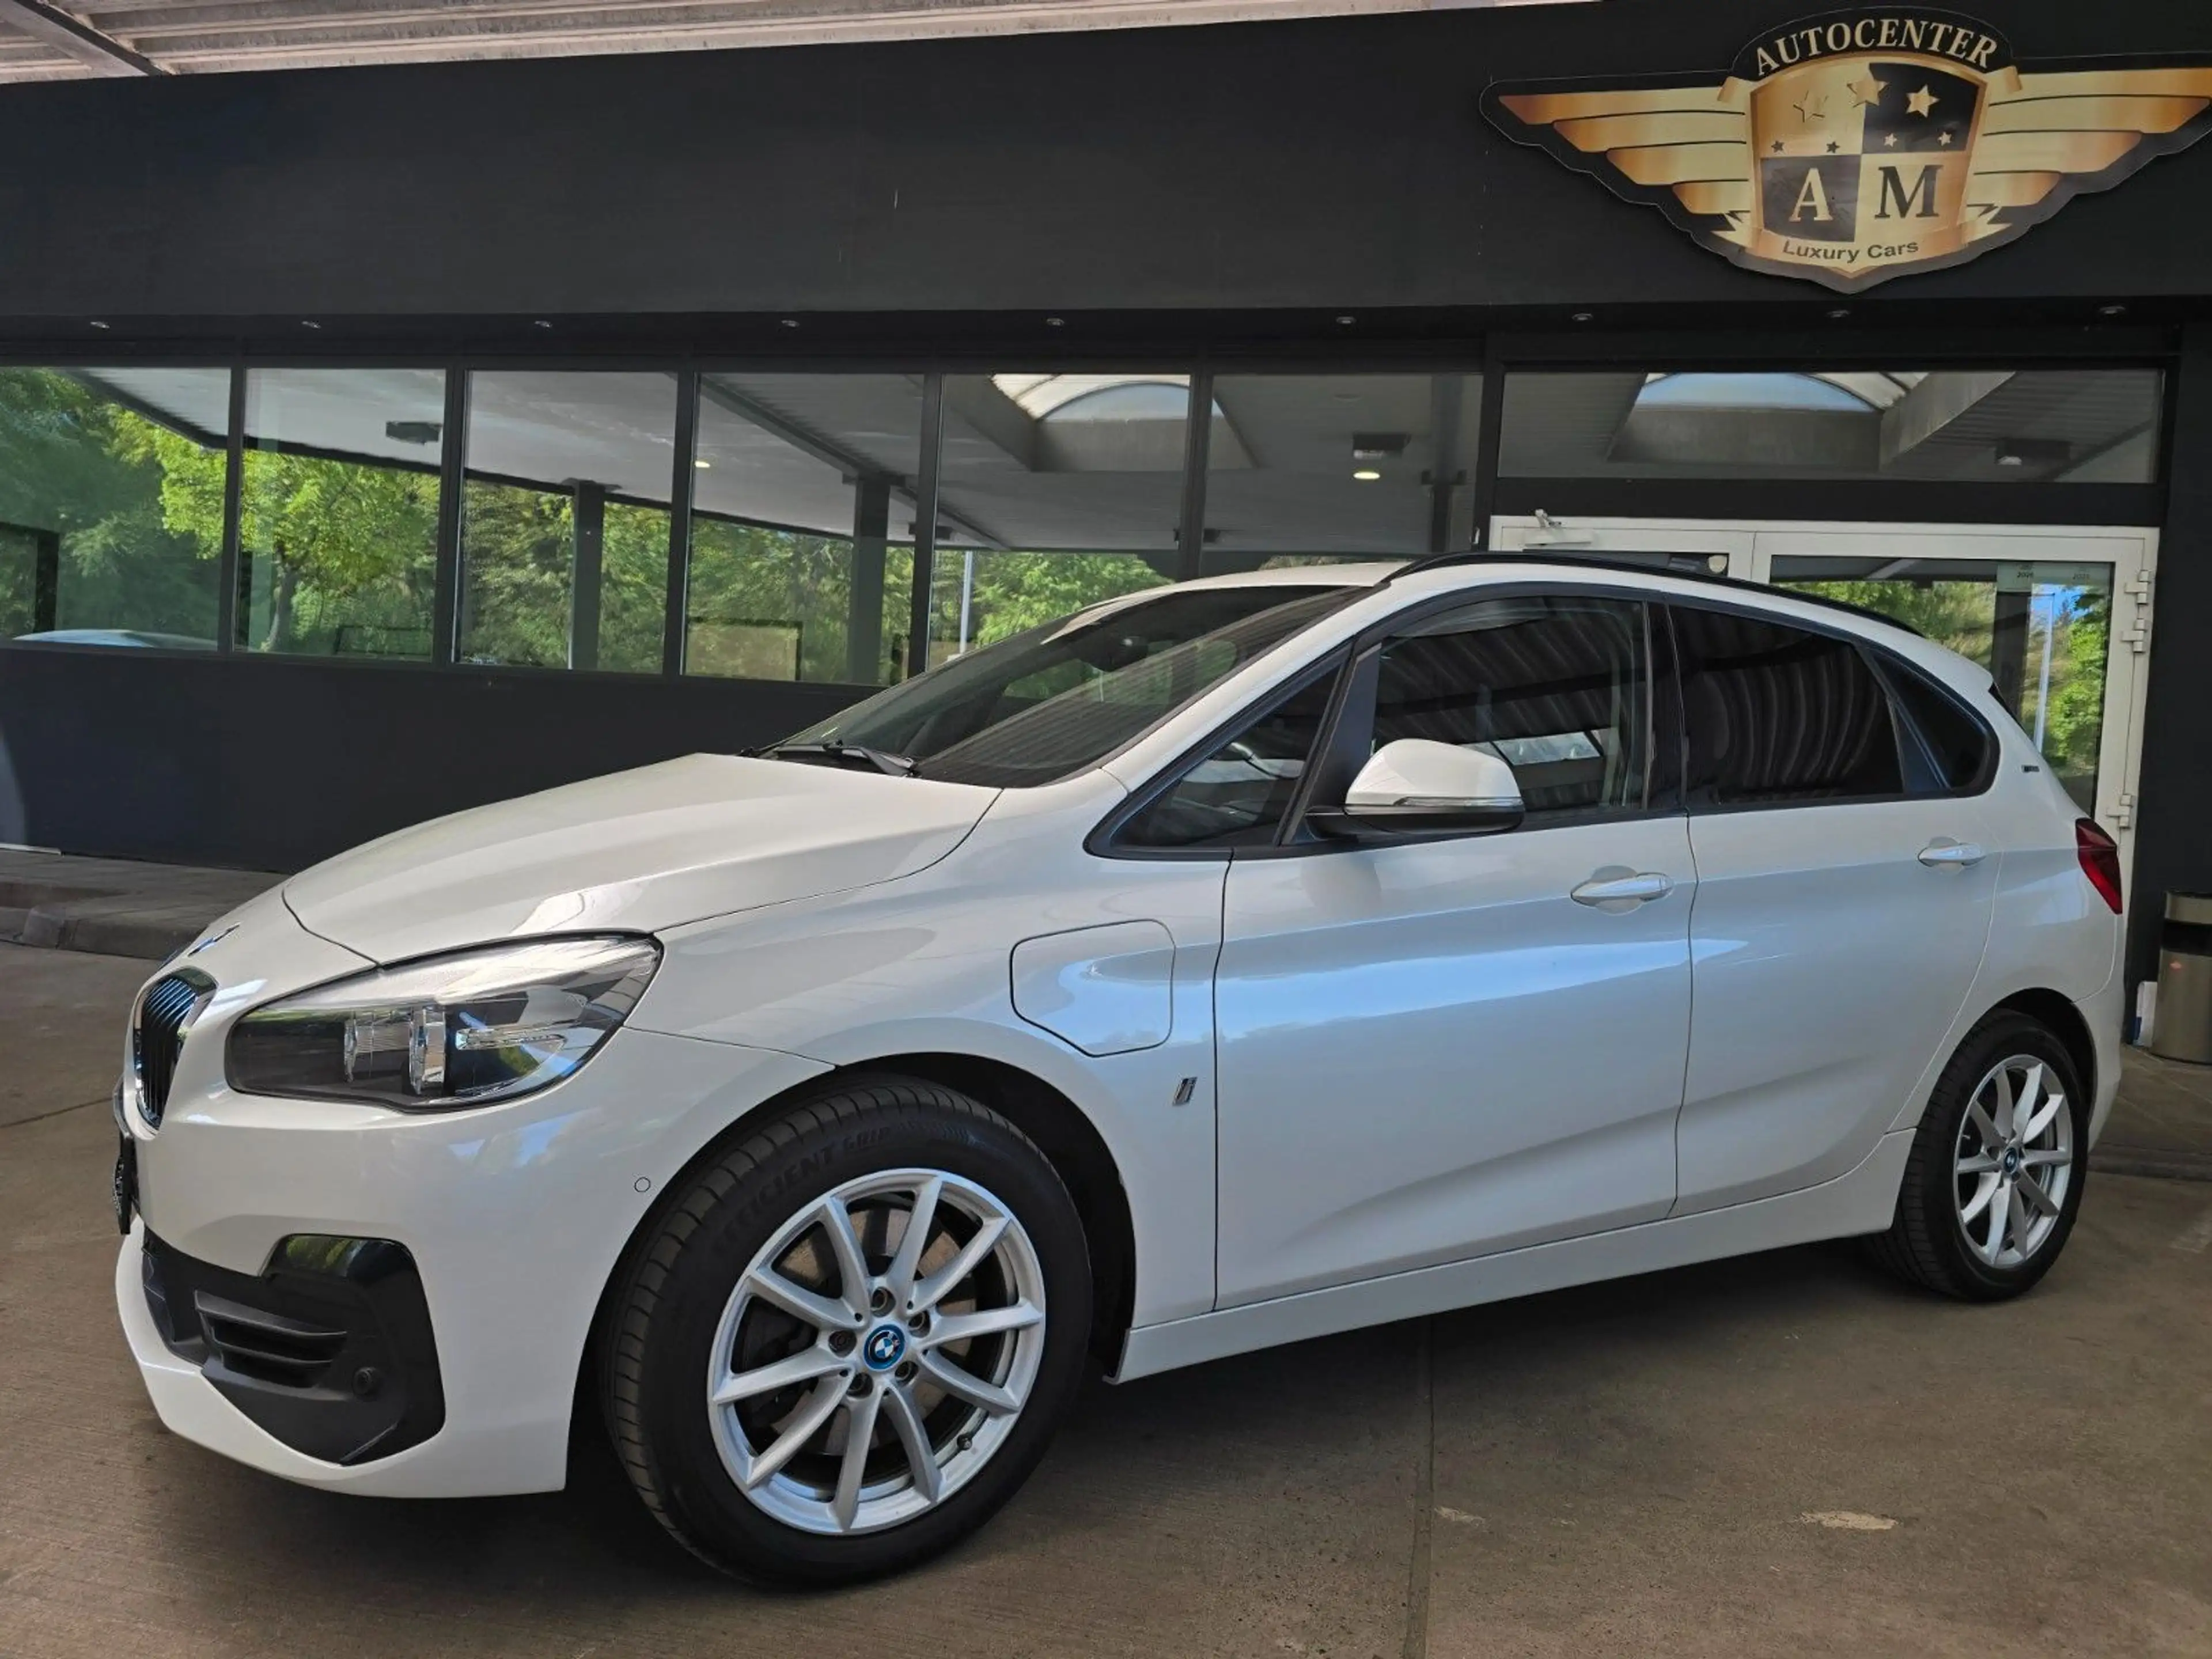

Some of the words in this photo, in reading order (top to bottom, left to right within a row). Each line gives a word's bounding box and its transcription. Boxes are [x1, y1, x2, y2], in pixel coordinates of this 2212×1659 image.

[1756, 18, 1997, 75] AUTOCENTER
[1789, 168, 1834, 222] A
[1874, 165, 1944, 218] M
[1783, 240, 1860, 264] Luxury
[1868, 242, 1919, 259] Cars
